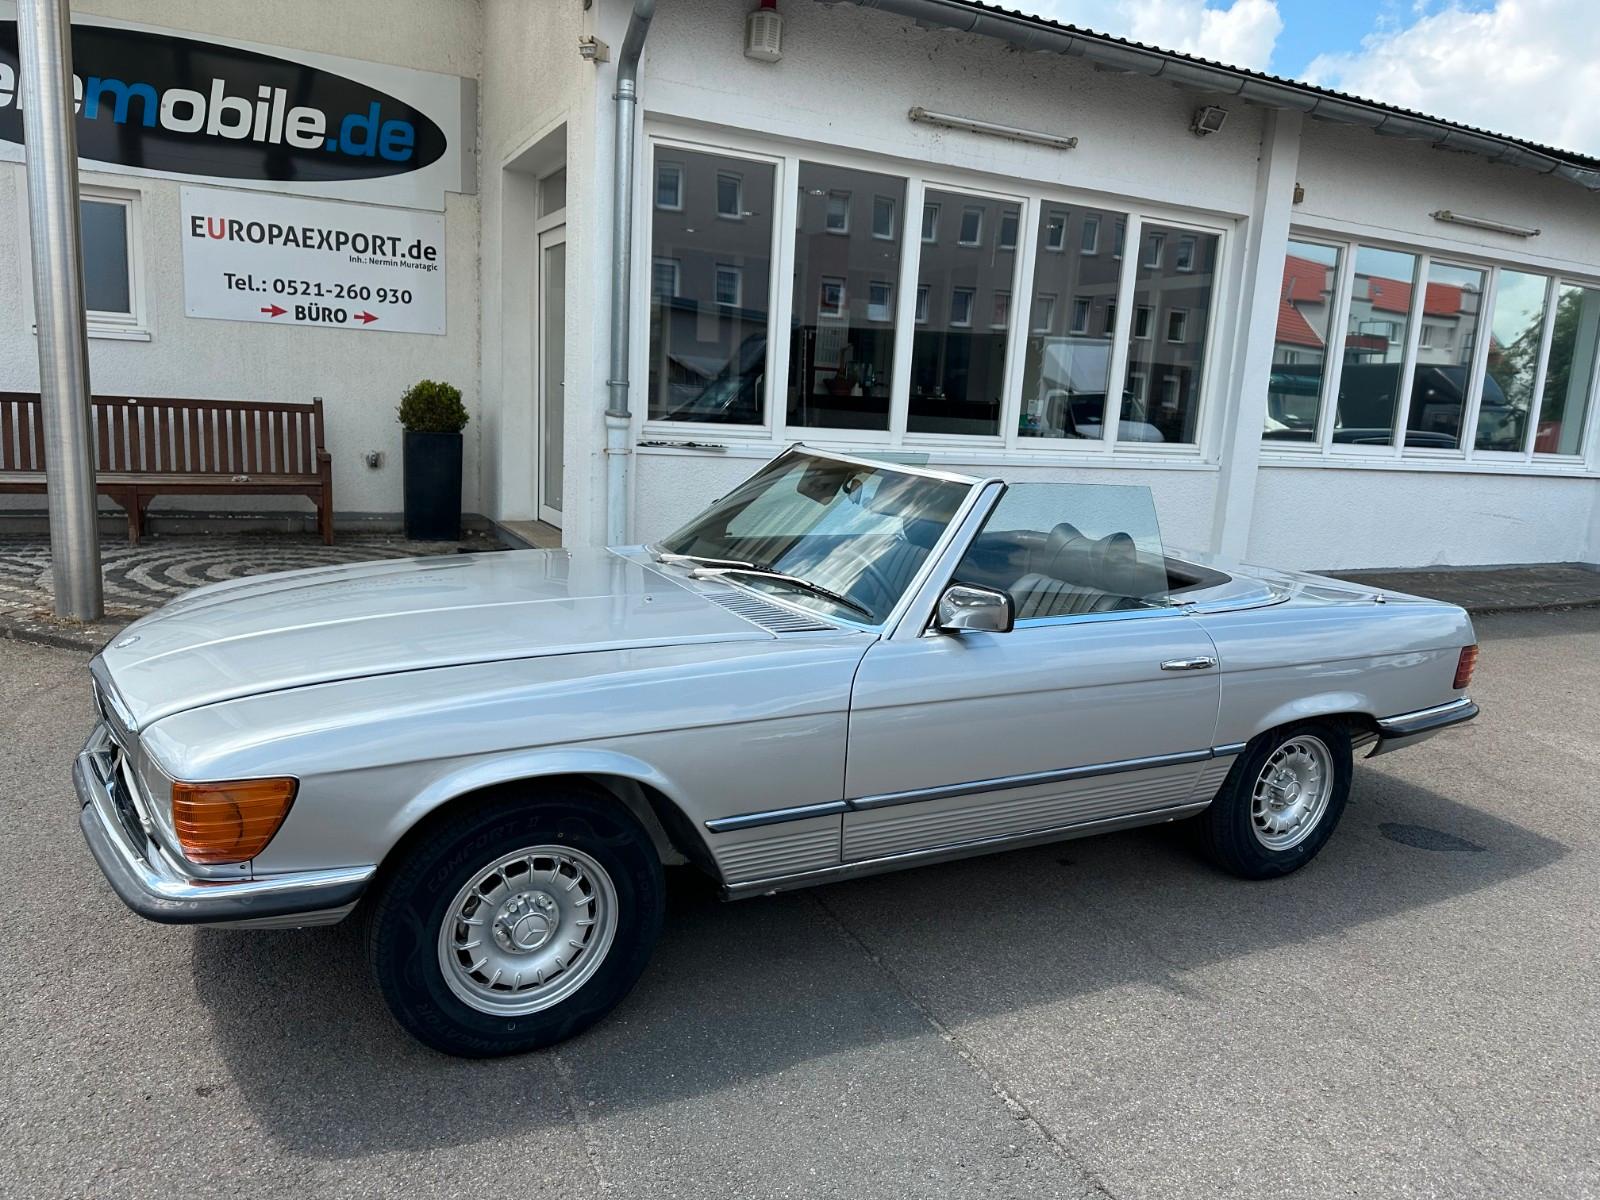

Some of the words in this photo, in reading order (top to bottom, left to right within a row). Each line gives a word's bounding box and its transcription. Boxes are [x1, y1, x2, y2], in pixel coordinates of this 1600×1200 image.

[191, 215, 437, 261] EUROPAEXPORT.de
[350, 255, 367, 265] Inh.:
[369, 257, 398, 267] Nermin
[400, 260, 438, 272] Muratagic
[224, 273, 267, 292] Tel.:
[273, 278, 371, 301] 0521-260
[376, 288, 412, 304] 930
[295, 302, 347, 323] BÜRO
